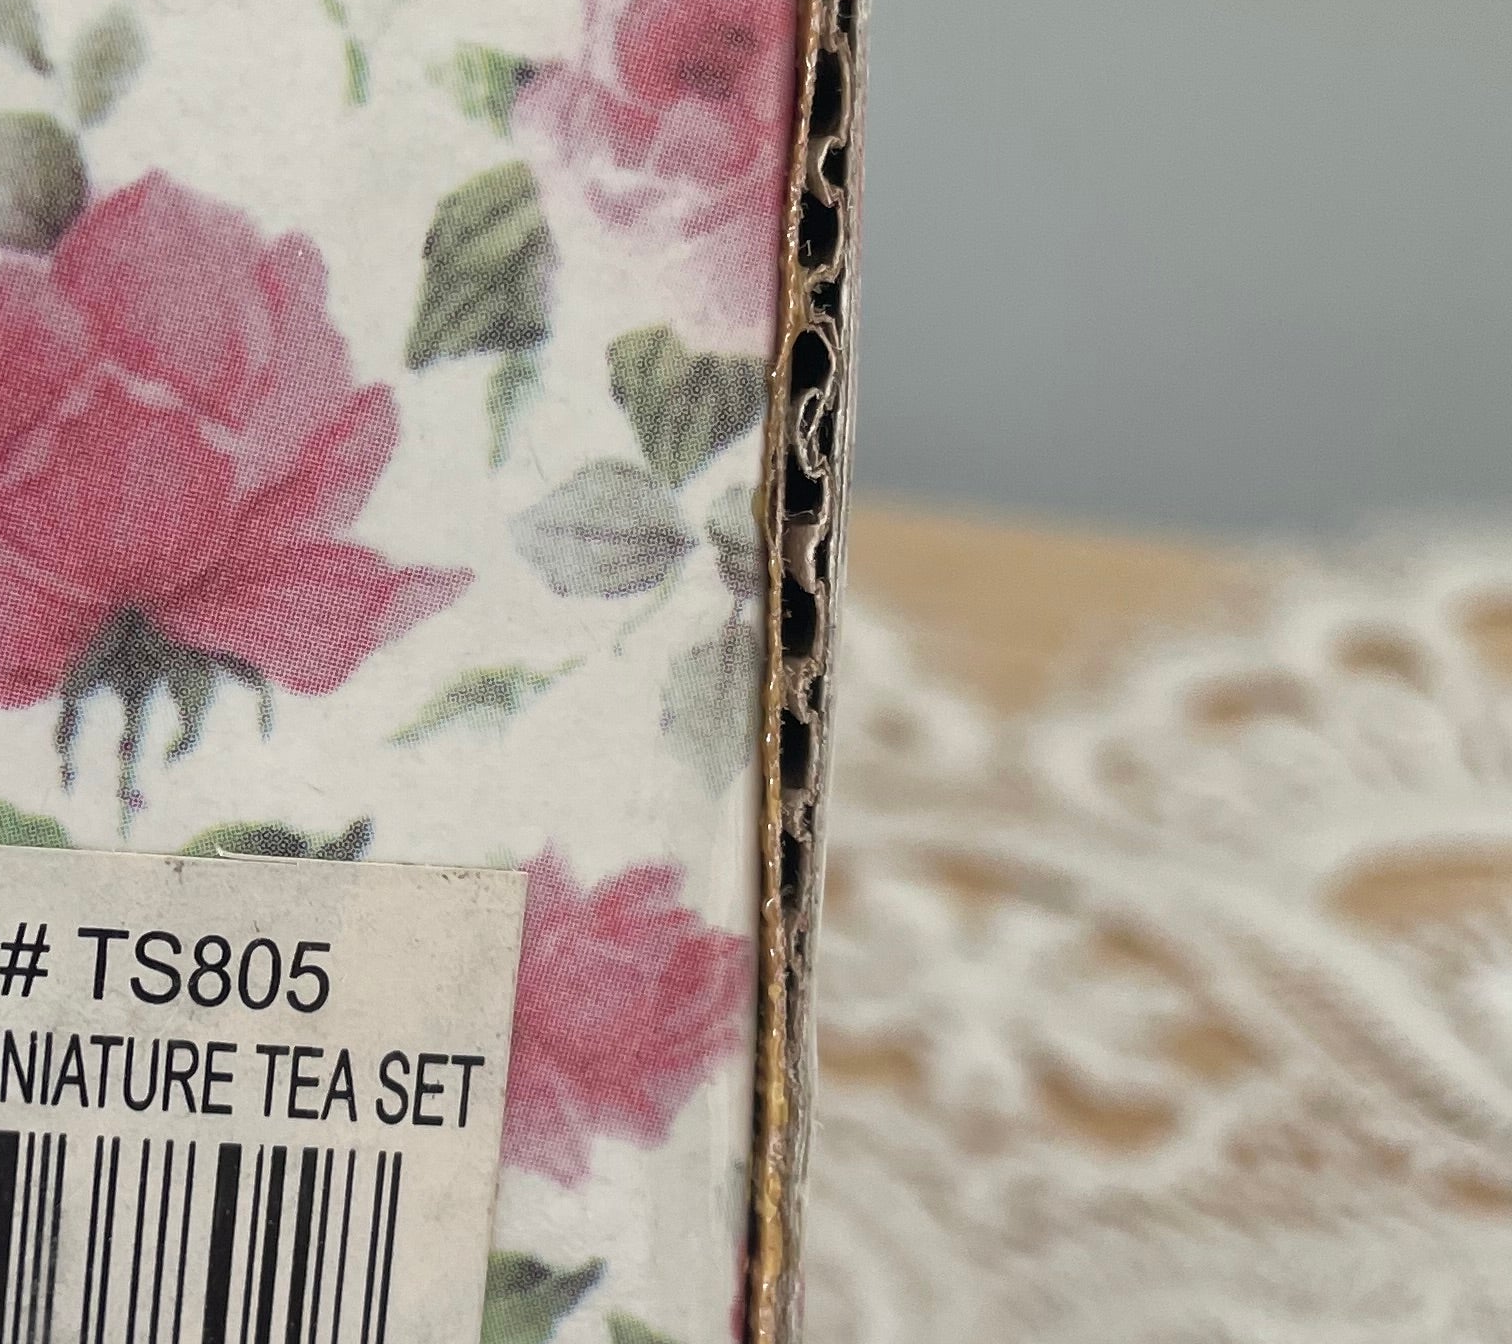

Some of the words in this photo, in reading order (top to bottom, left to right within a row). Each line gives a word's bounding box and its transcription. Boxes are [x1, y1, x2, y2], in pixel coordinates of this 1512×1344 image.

[77, 926, 332, 1013] TS805
[255, 1043, 358, 1123] TEA
[375, 1049, 486, 1129] SET
